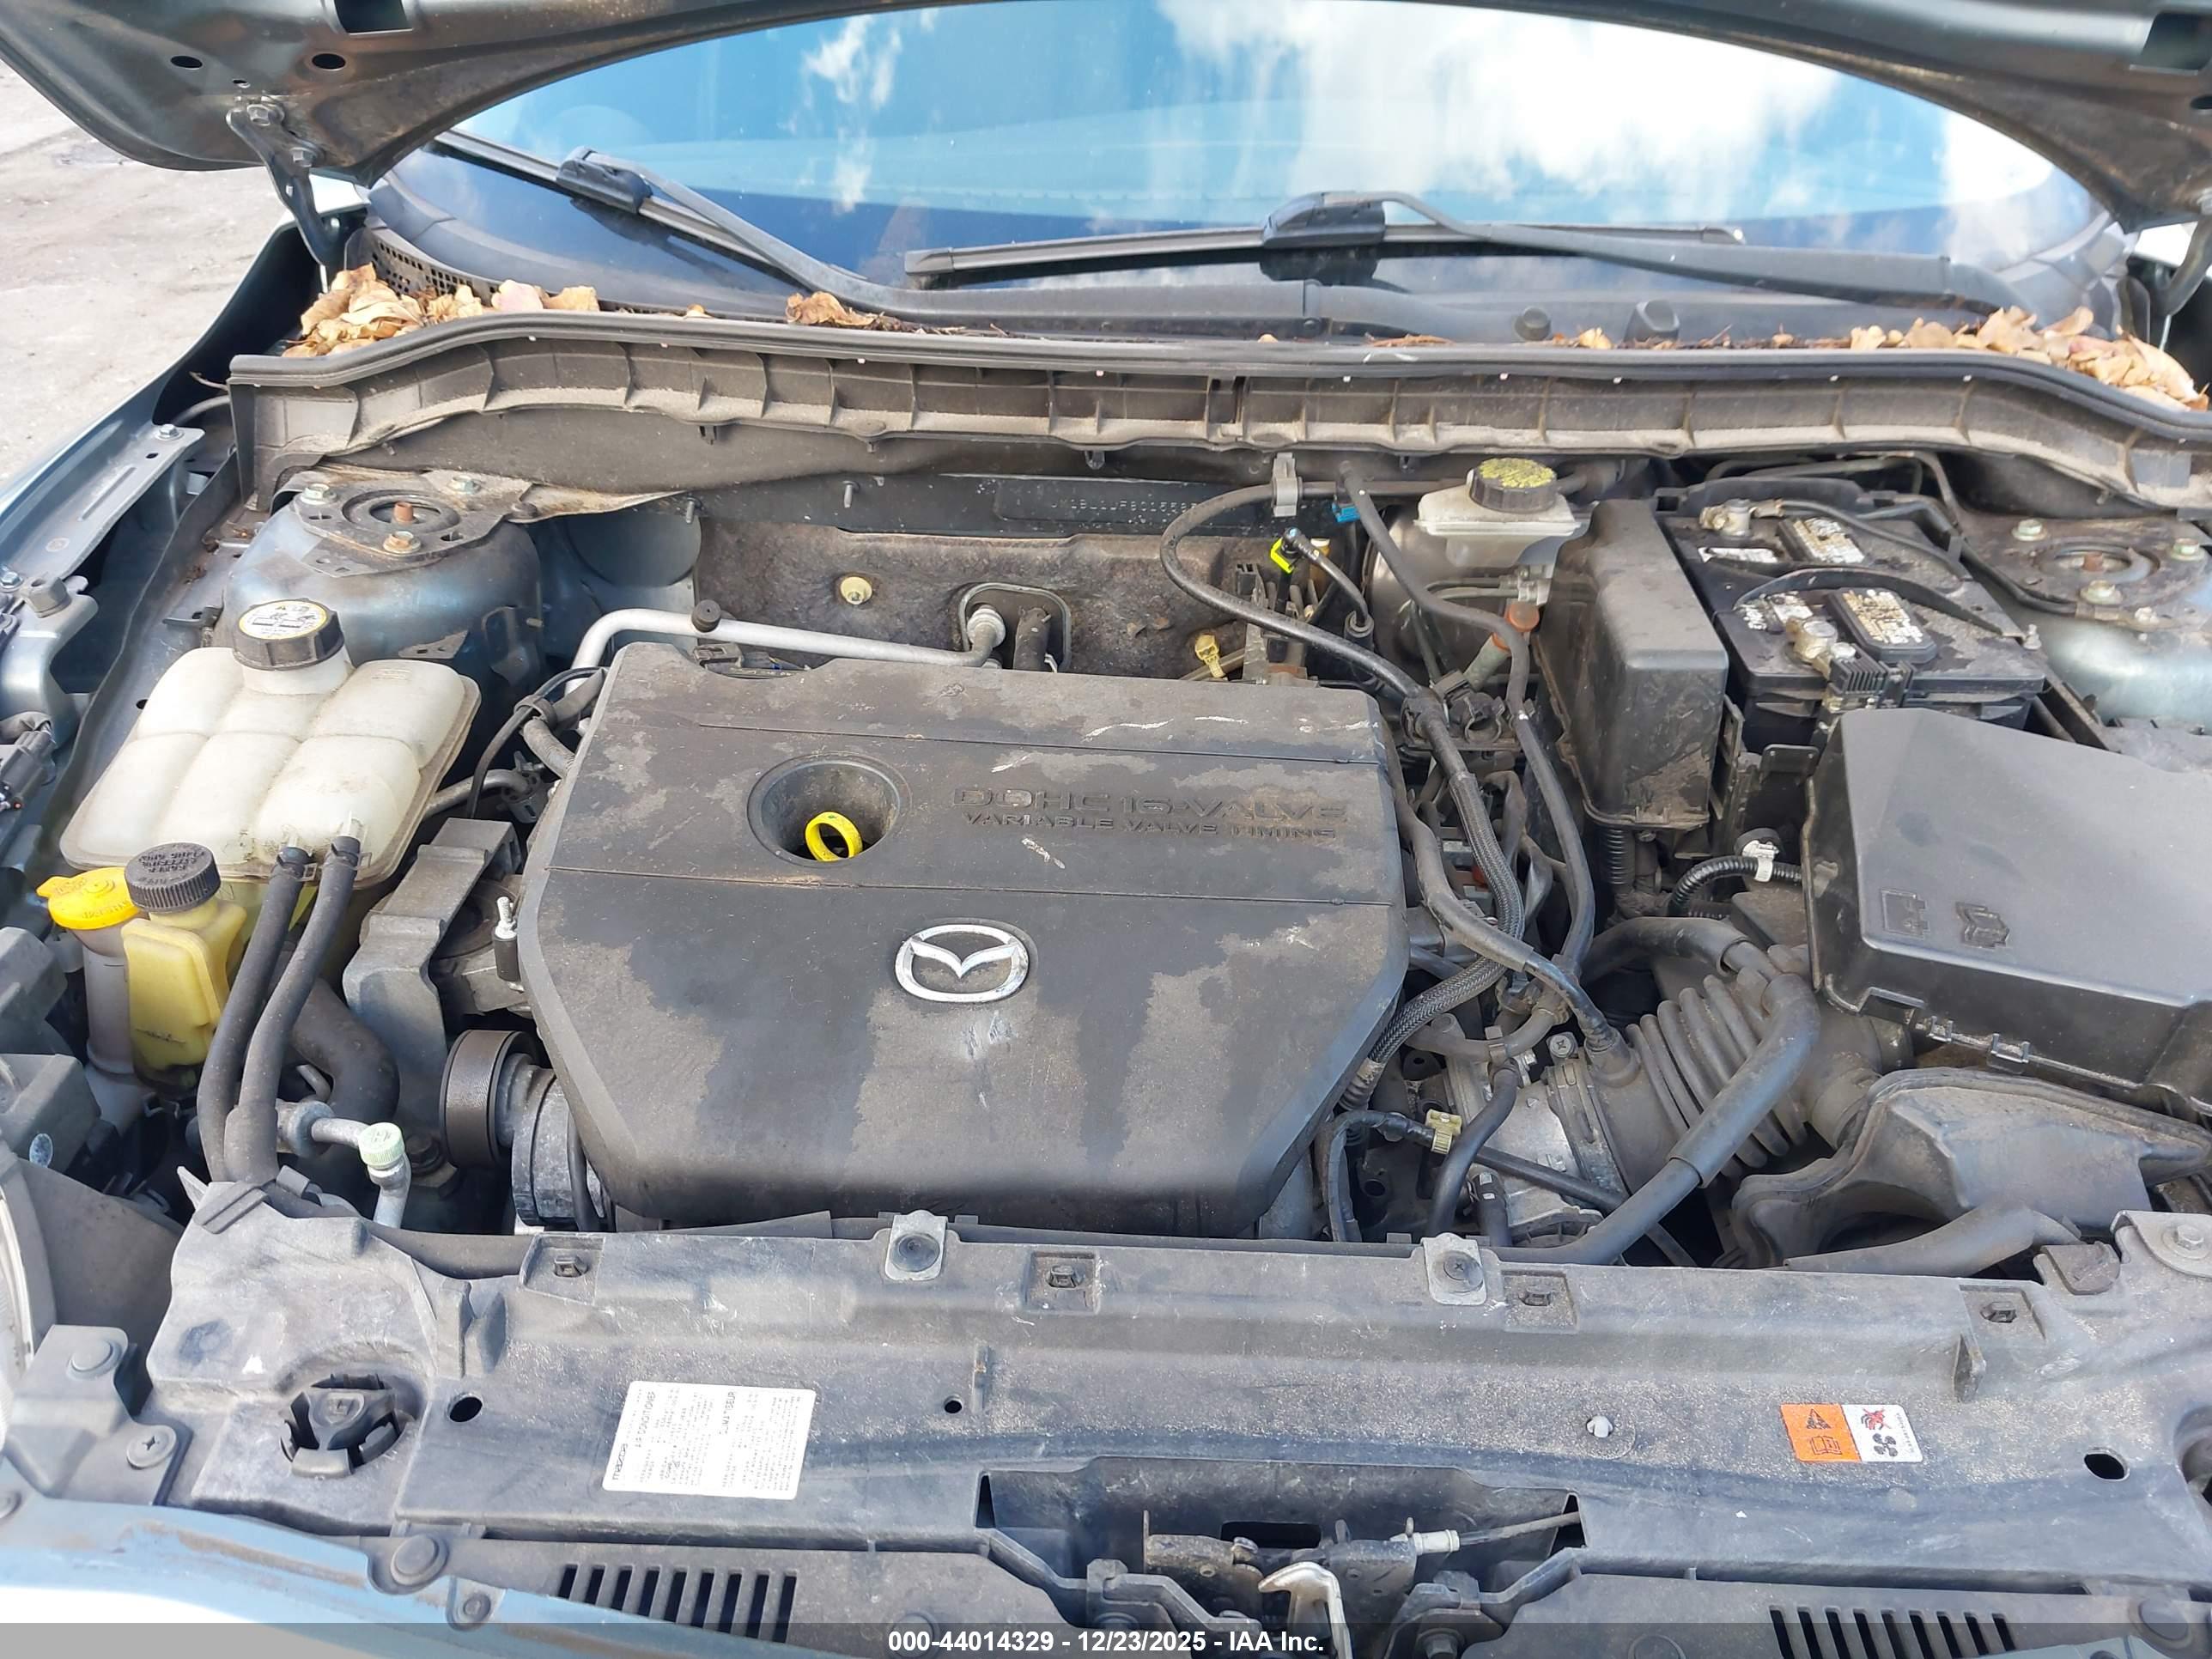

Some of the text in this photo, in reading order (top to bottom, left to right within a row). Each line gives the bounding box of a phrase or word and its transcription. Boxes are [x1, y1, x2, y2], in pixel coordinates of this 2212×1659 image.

[953, 787, 1348, 822] DOHC 16-VALVE
[962, 812, 1337, 839] VARIABLE VALVE TIMING
[611, 1443, 629, 1480] mazda
